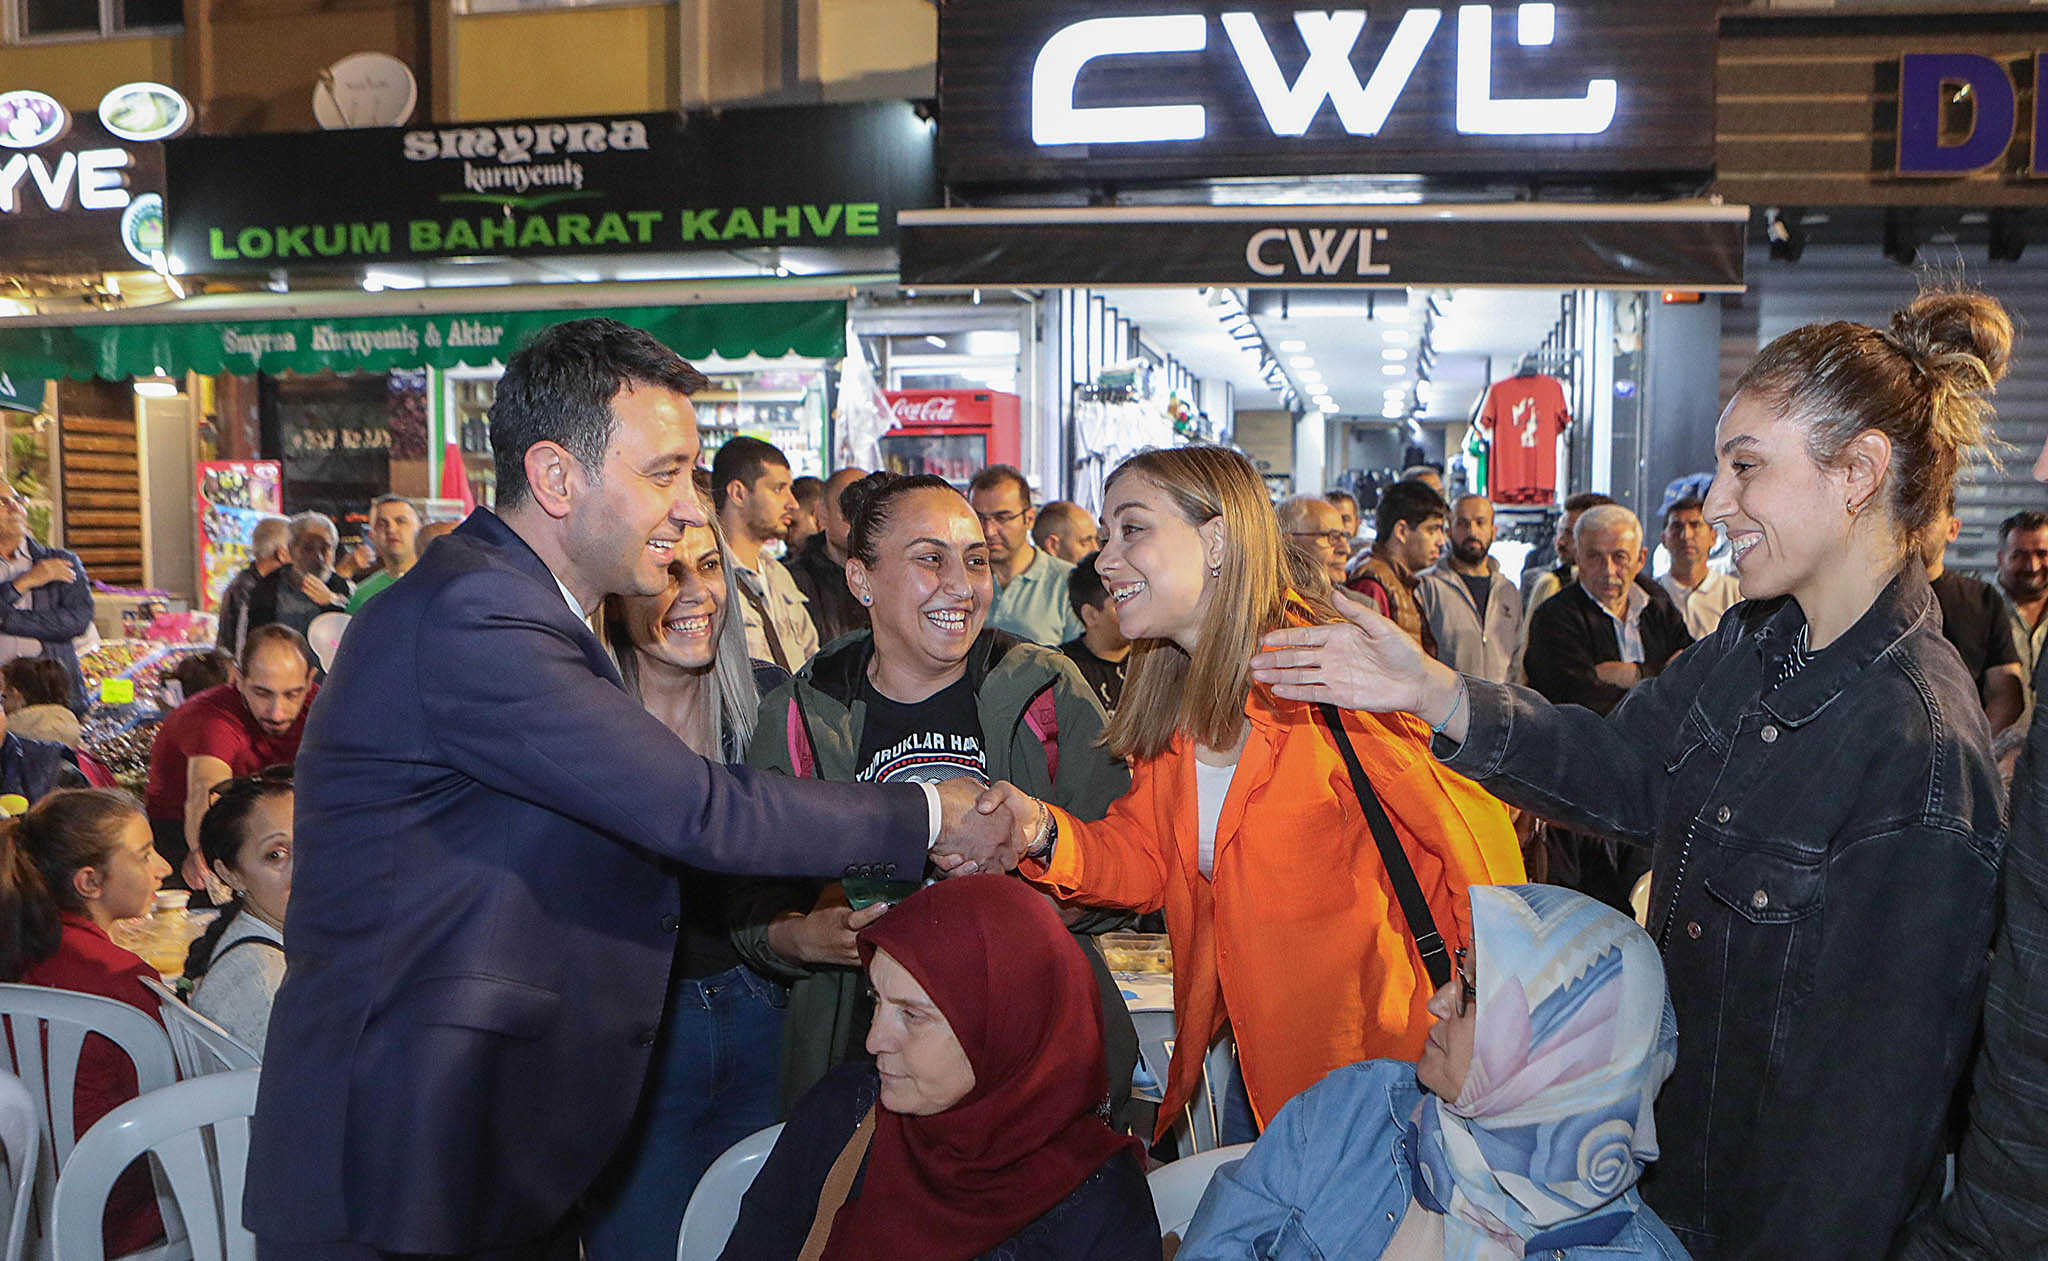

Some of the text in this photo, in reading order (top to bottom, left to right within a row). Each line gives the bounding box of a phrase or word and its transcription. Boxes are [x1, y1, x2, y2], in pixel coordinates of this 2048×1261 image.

[1032, 3, 1617, 146] CWL
[403, 119, 649, 164] smyrna
[209, 203, 880, 260] LOKUM BAHARAT KAHVE
[1246, 228, 1391, 276] CWL
[223, 327, 297, 361] Smyrna
[424, 321, 442, 348] &
[447, 319, 503, 347] Aktar
